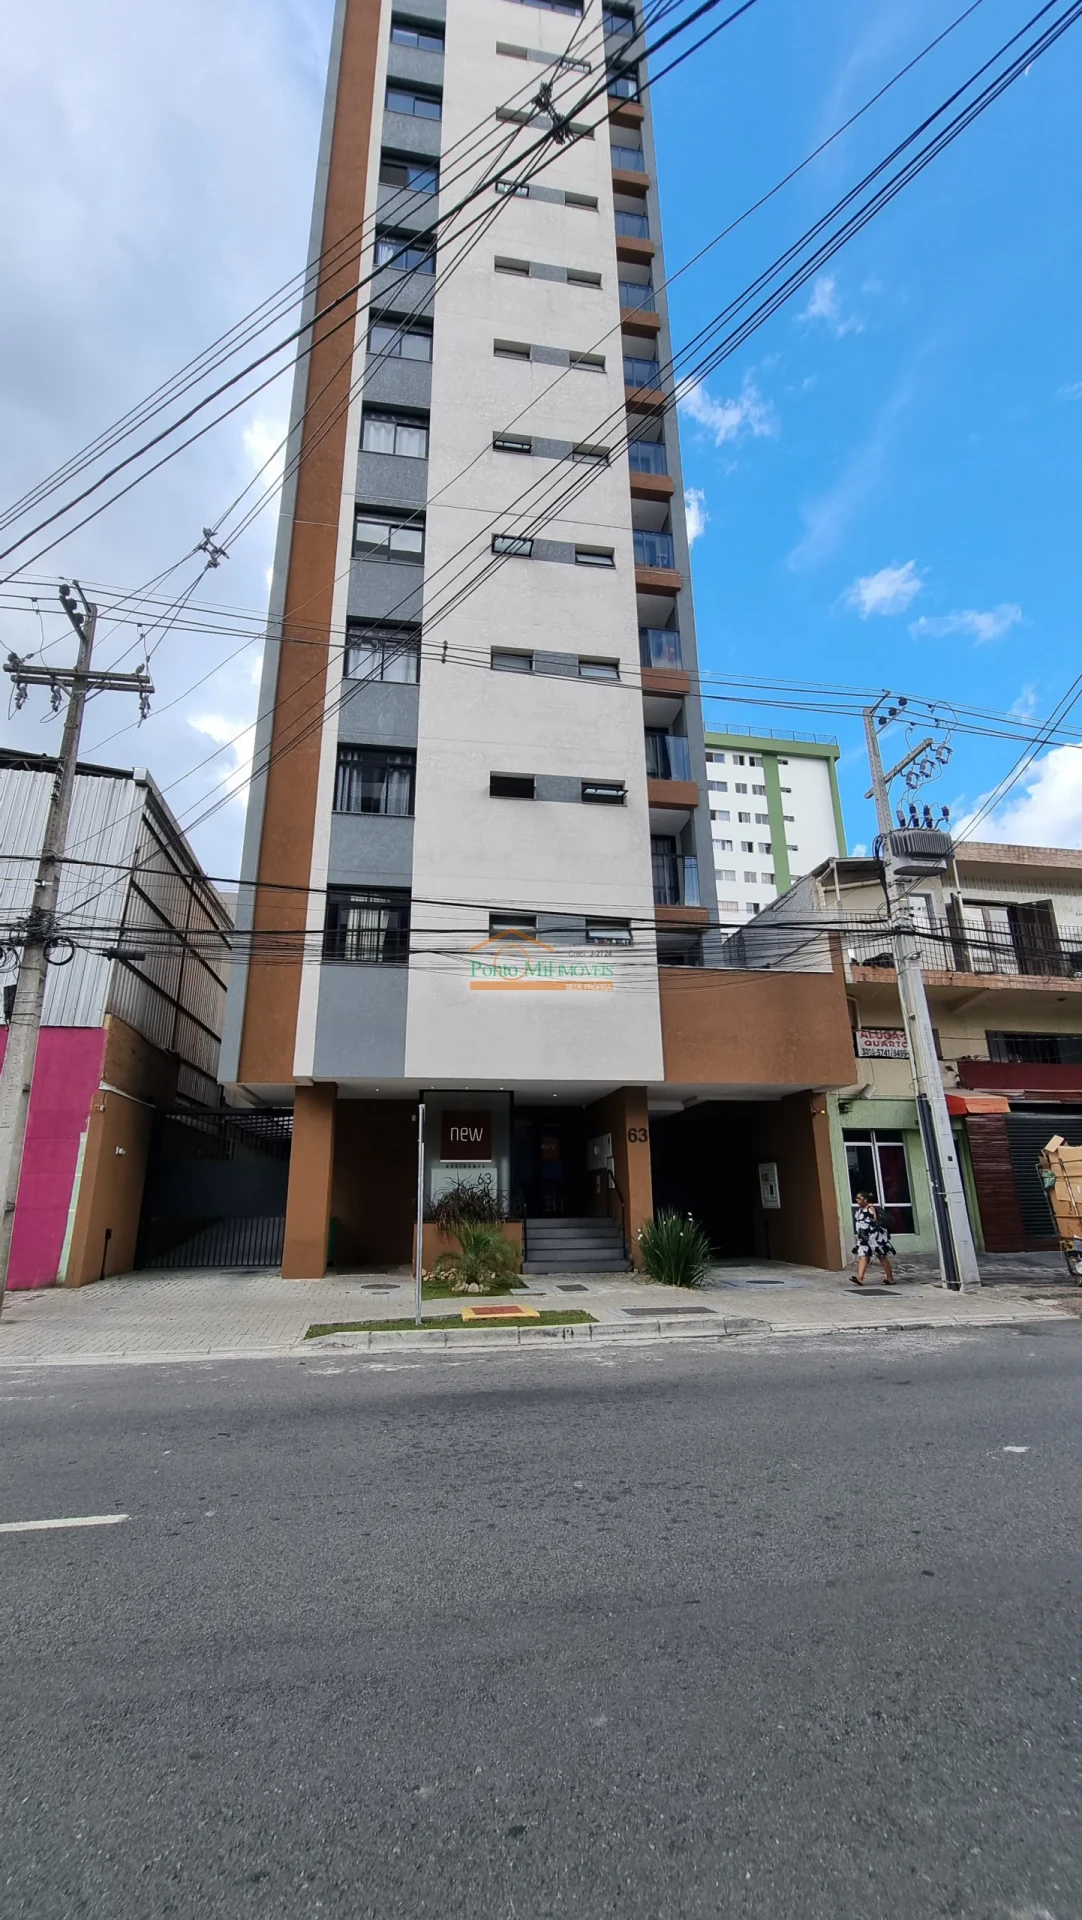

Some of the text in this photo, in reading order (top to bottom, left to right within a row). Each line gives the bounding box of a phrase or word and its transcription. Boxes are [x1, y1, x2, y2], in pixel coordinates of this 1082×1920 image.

[450, 1127, 484, 1142] new
[627, 1127, 648, 1143] 63
[477, 1172, 492, 1185] 63
